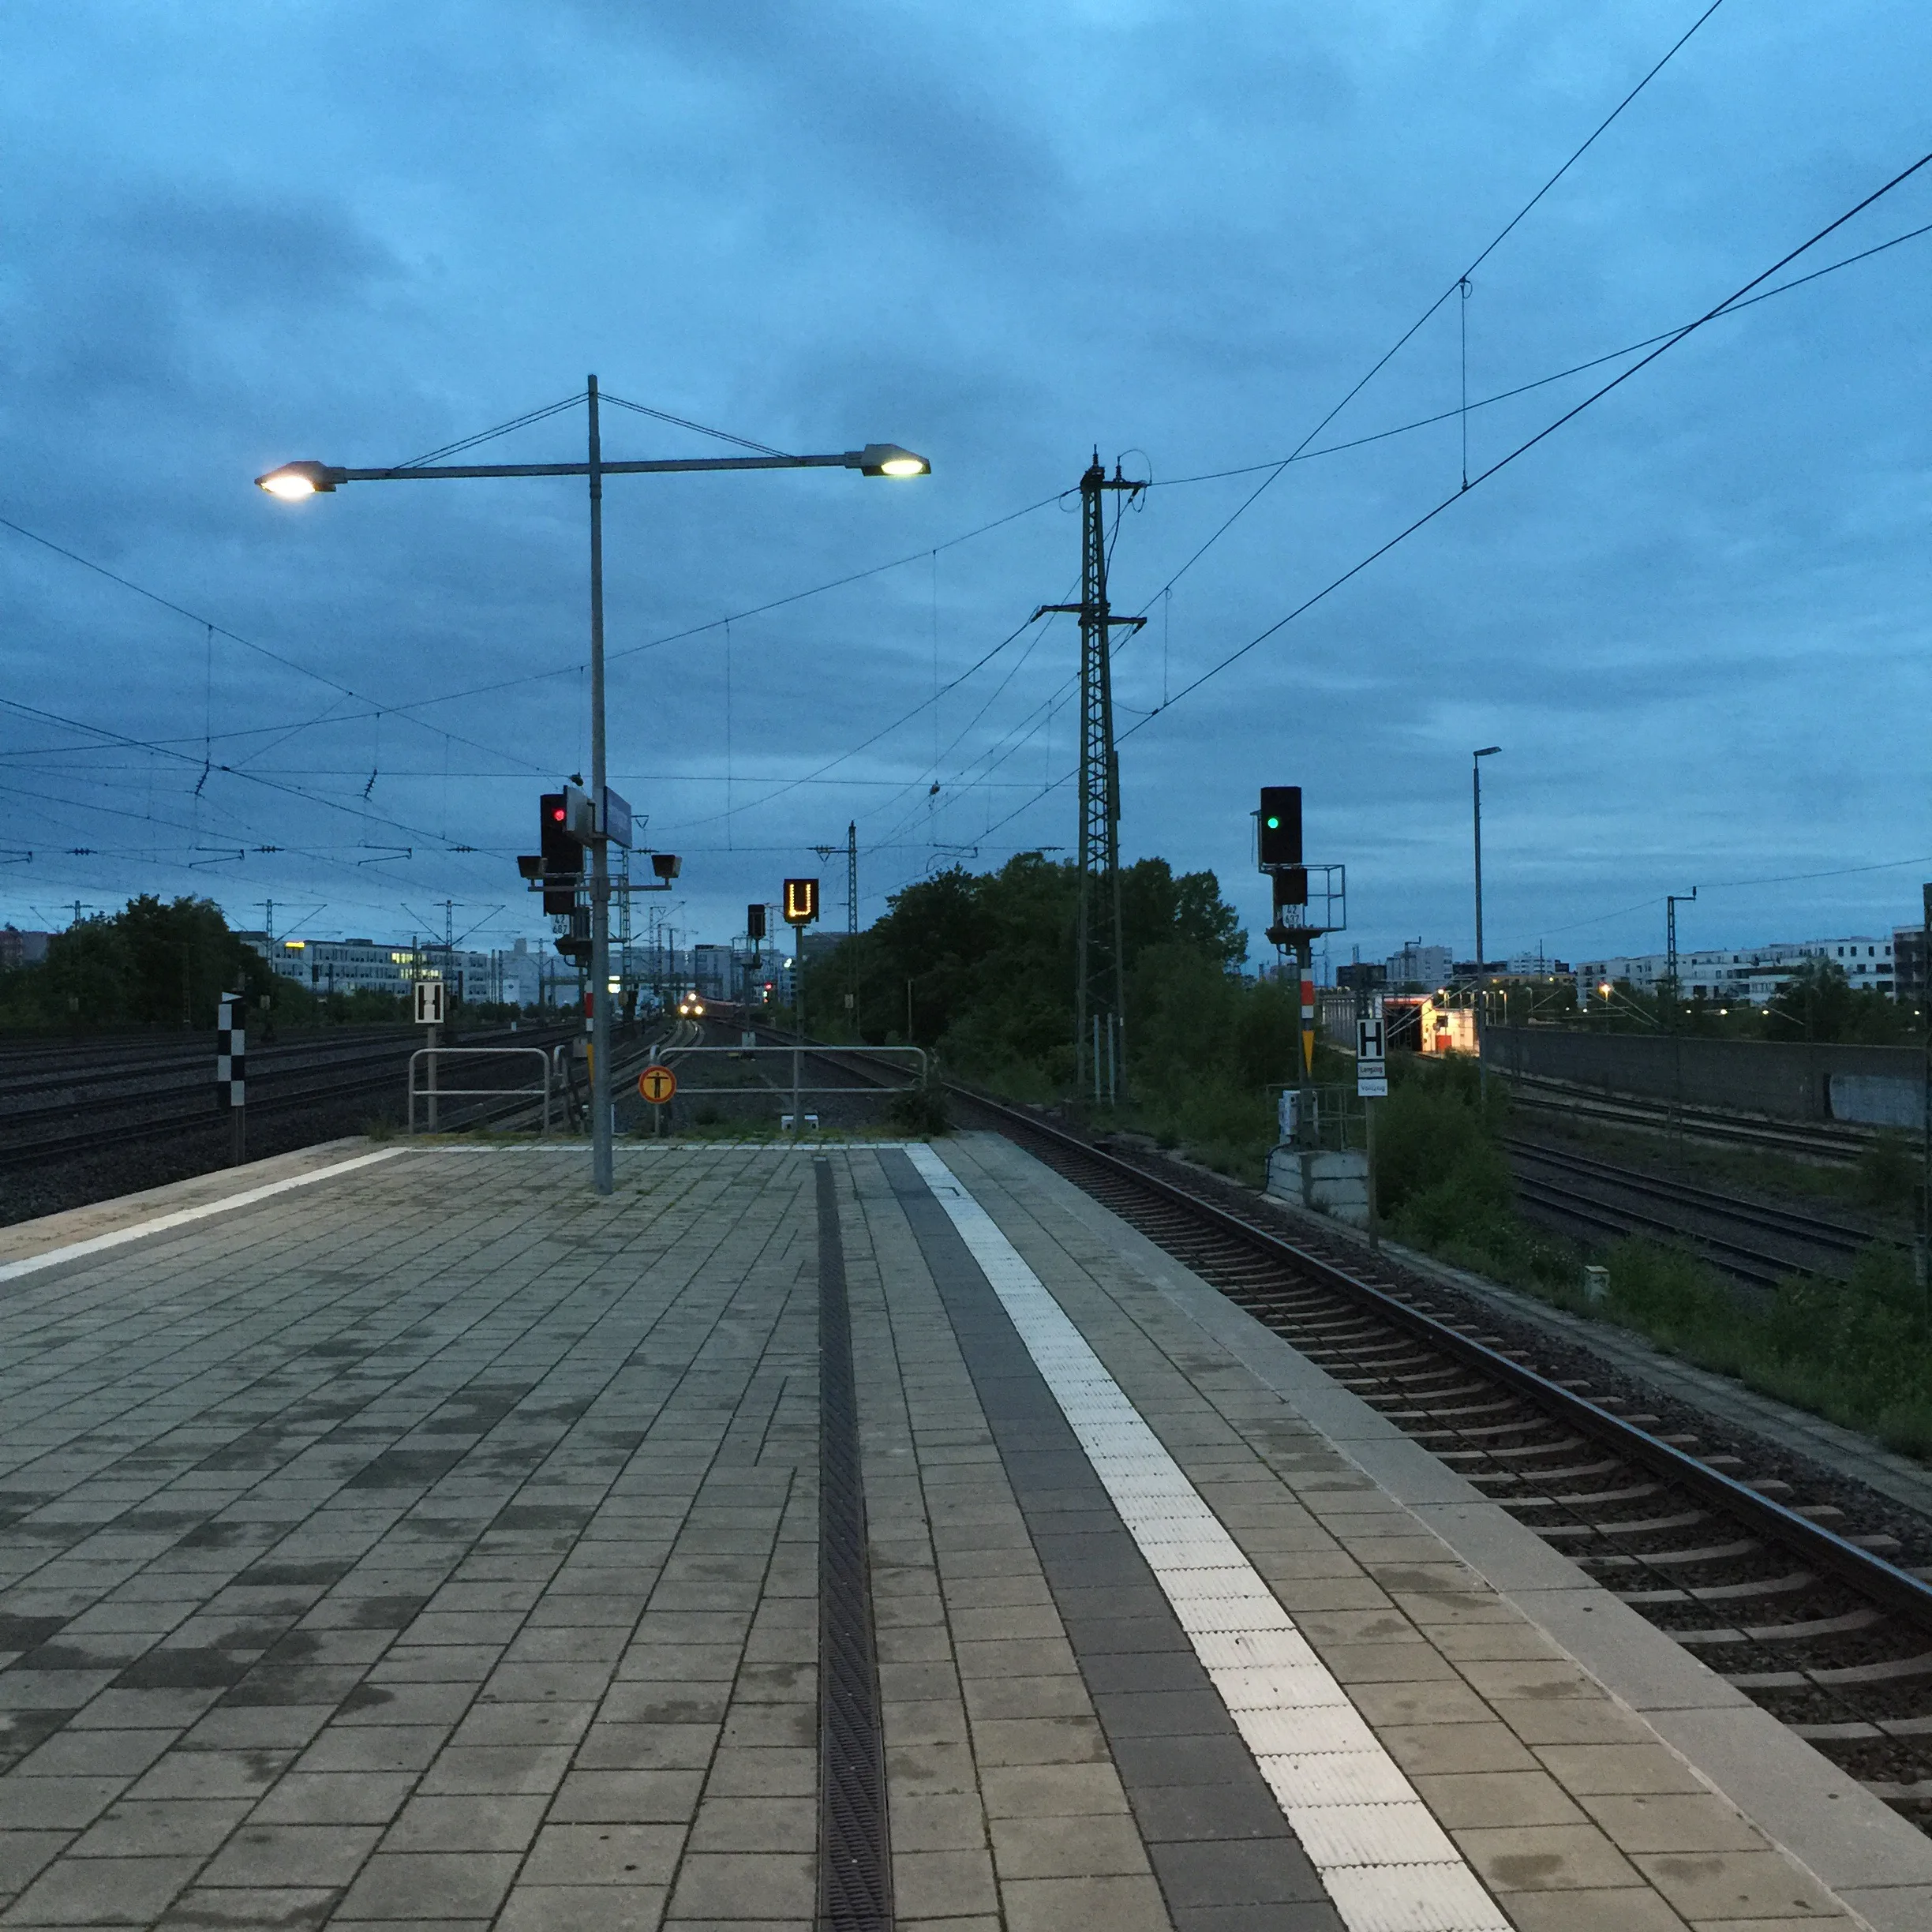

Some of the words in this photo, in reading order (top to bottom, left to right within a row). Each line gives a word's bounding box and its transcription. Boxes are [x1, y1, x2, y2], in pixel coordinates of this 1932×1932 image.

[789, 883, 811, 917] U
[552, 924, 568, 934] 687
[555, 914, 565, 924] 42
[418, 985, 441, 1020] H
[1360, 1021, 1382, 1057] H
